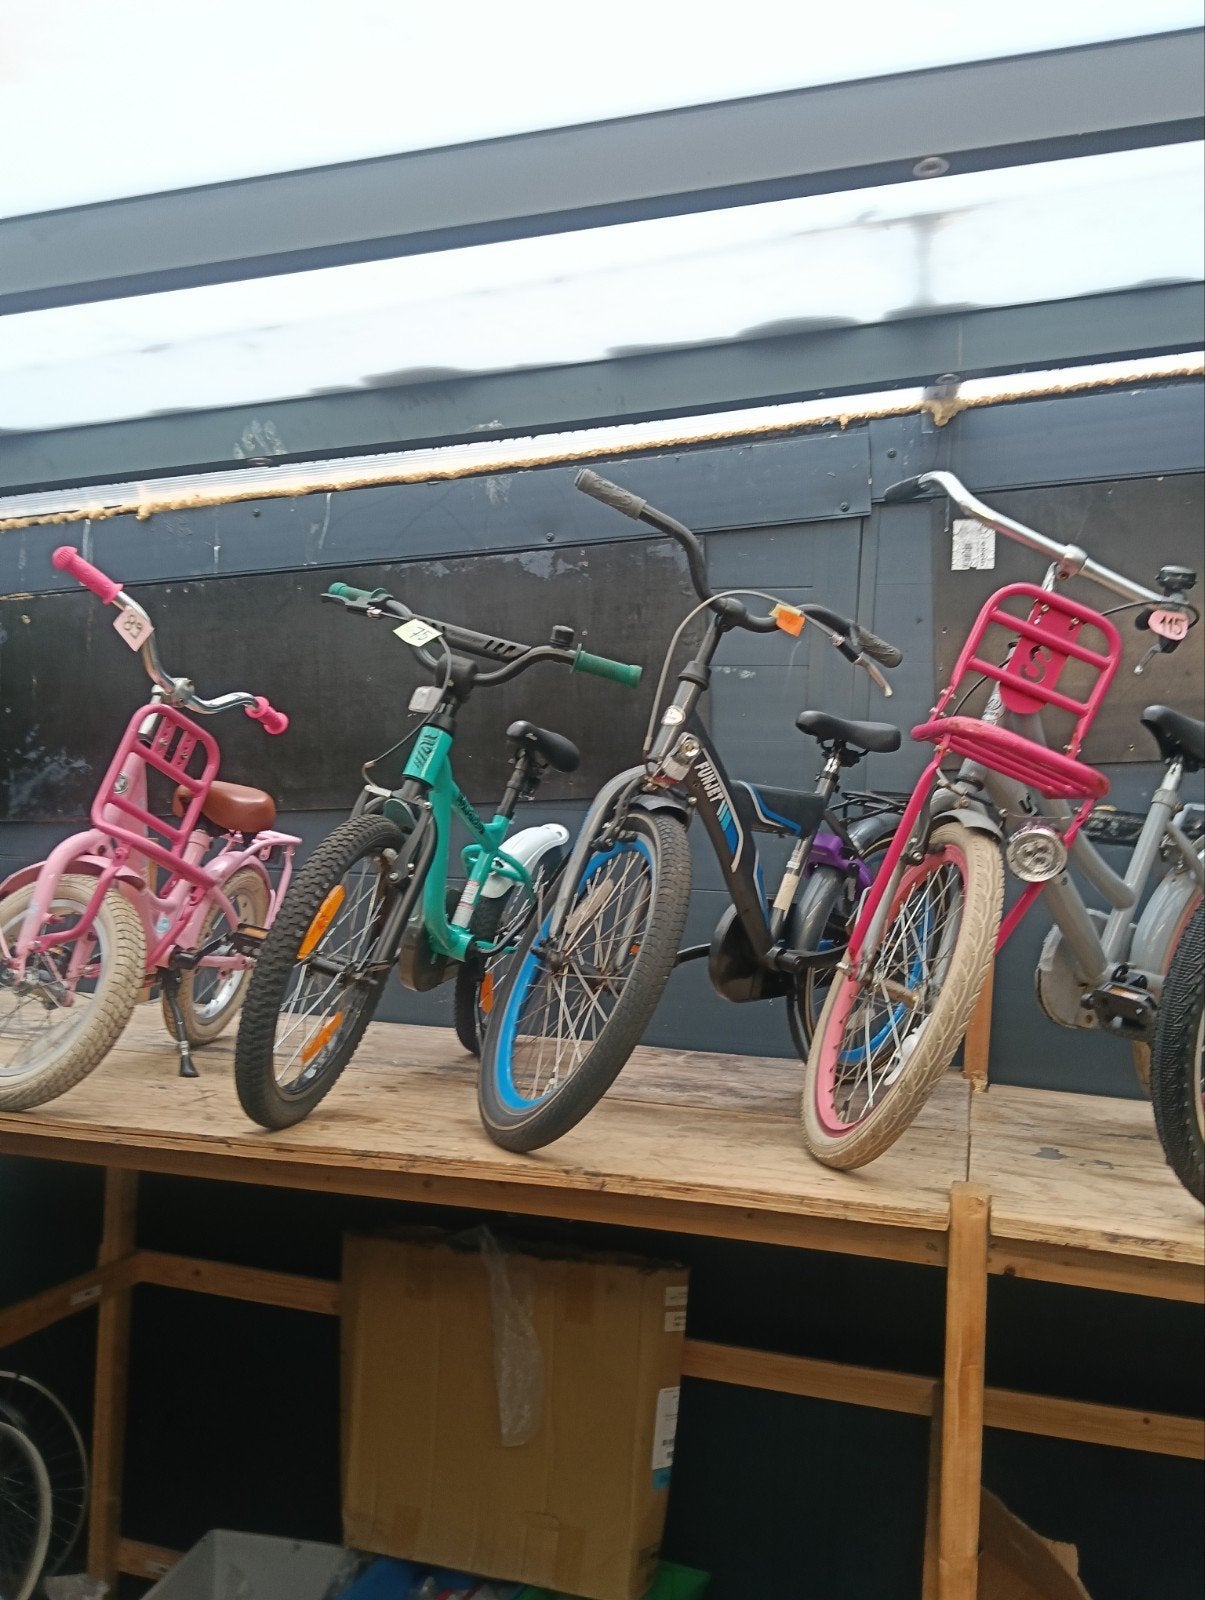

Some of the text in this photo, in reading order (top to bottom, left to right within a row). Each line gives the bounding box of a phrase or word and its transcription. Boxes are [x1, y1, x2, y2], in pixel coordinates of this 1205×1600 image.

[409, 626, 433, 641] 75
[1159, 615, 1186, 636] 115
[694, 761, 726, 803] FUNJET
